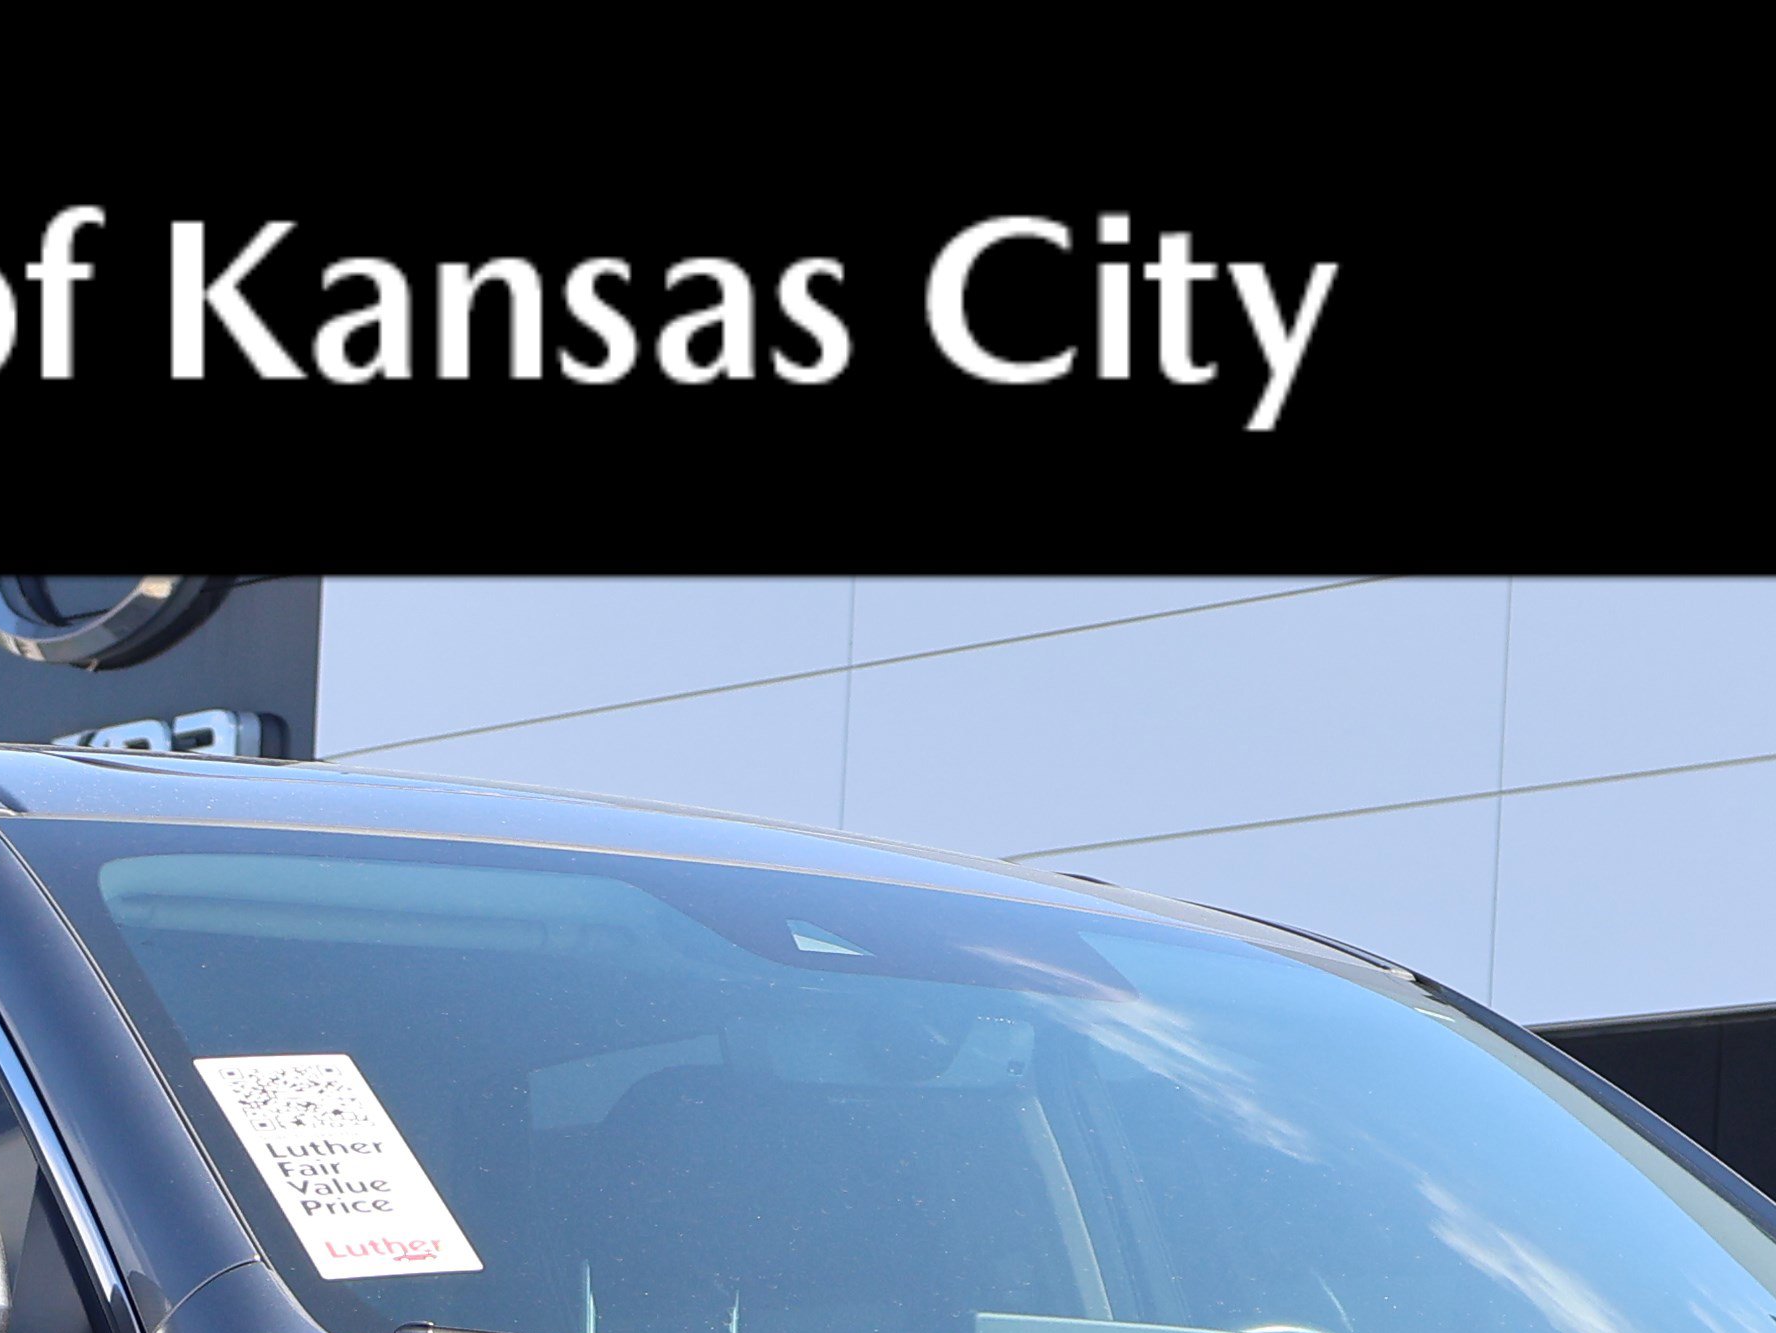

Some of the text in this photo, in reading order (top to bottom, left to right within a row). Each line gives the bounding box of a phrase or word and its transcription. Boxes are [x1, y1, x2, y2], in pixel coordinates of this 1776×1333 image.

[266, 1139, 383, 1158] Luther
[277, 1159, 340, 1177] Fair
[287, 1178, 391, 1195] Value
[300, 1197, 393, 1216] Price
[325, 1236, 441, 1259] Luther
